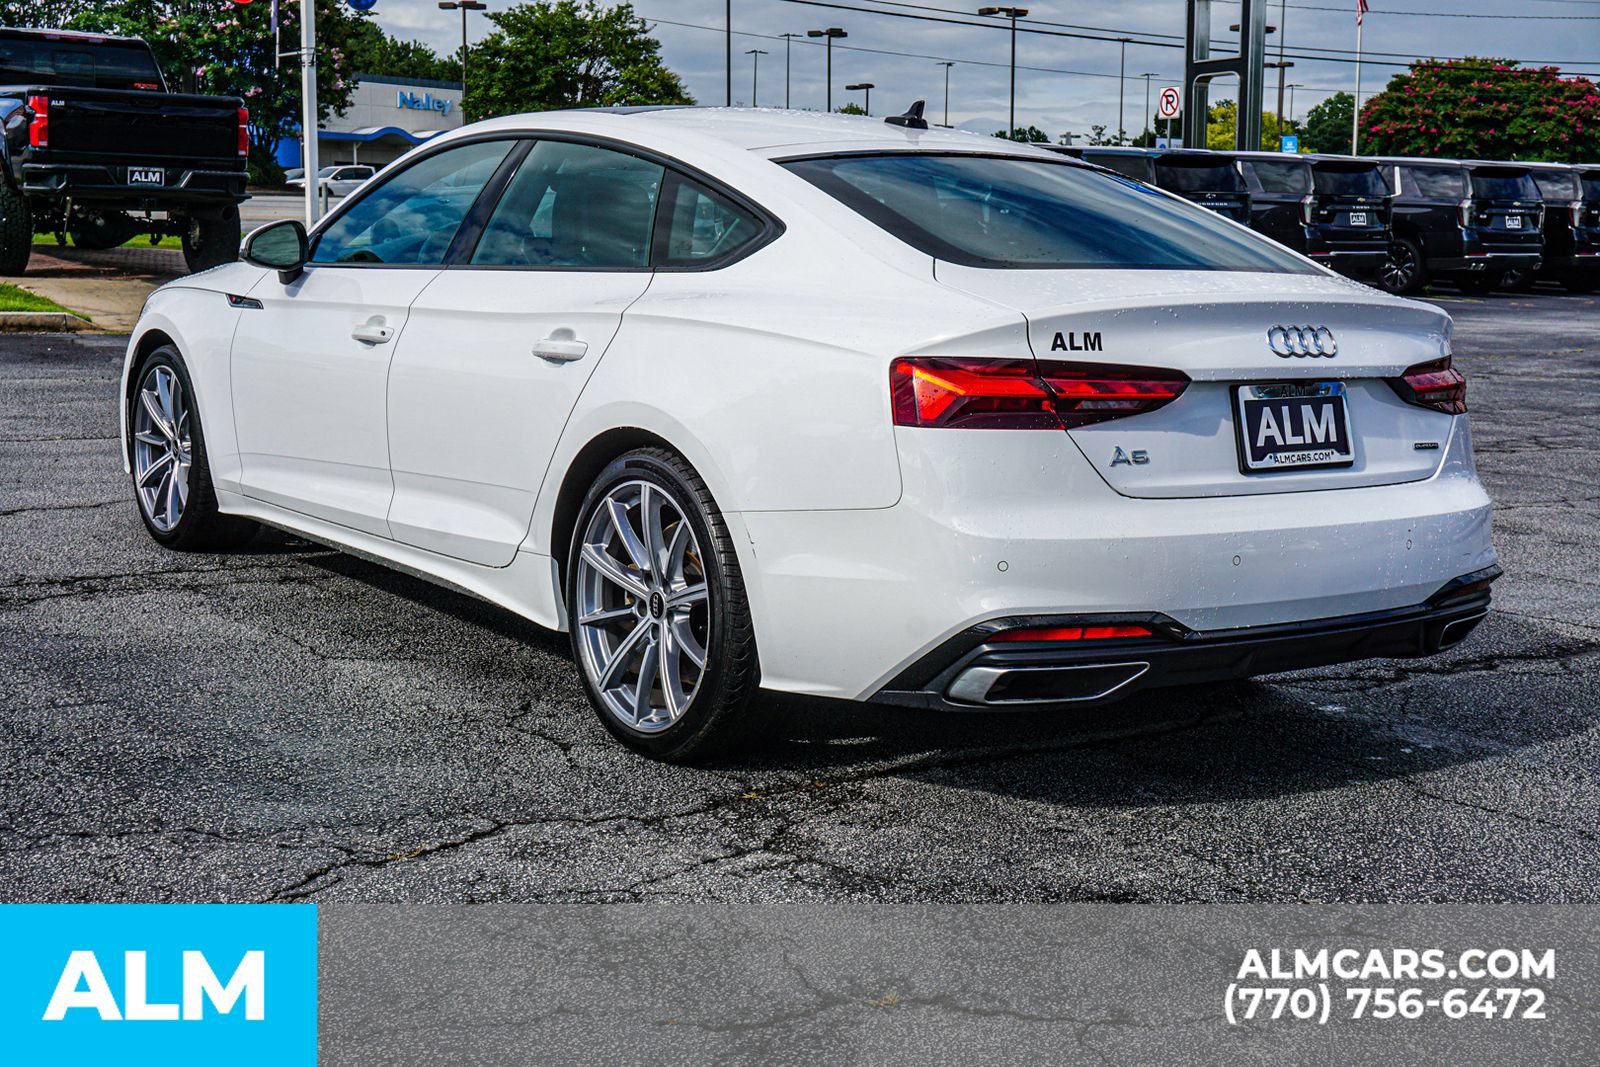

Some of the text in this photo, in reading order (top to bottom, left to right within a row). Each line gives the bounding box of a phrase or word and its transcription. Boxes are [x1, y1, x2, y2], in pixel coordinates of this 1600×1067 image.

[396, 91, 452, 117] Nalley
[1164, 94, 1175, 112] P
[132, 171, 160, 182] ALM
[1050, 332, 1103, 352] ALM
[1280, 385, 1307, 398] ALM
[1256, 403, 1338, 448] ALM
[1109, 446, 1151, 468] A5
[1274, 451, 1332, 465] ALMCARS.COM
